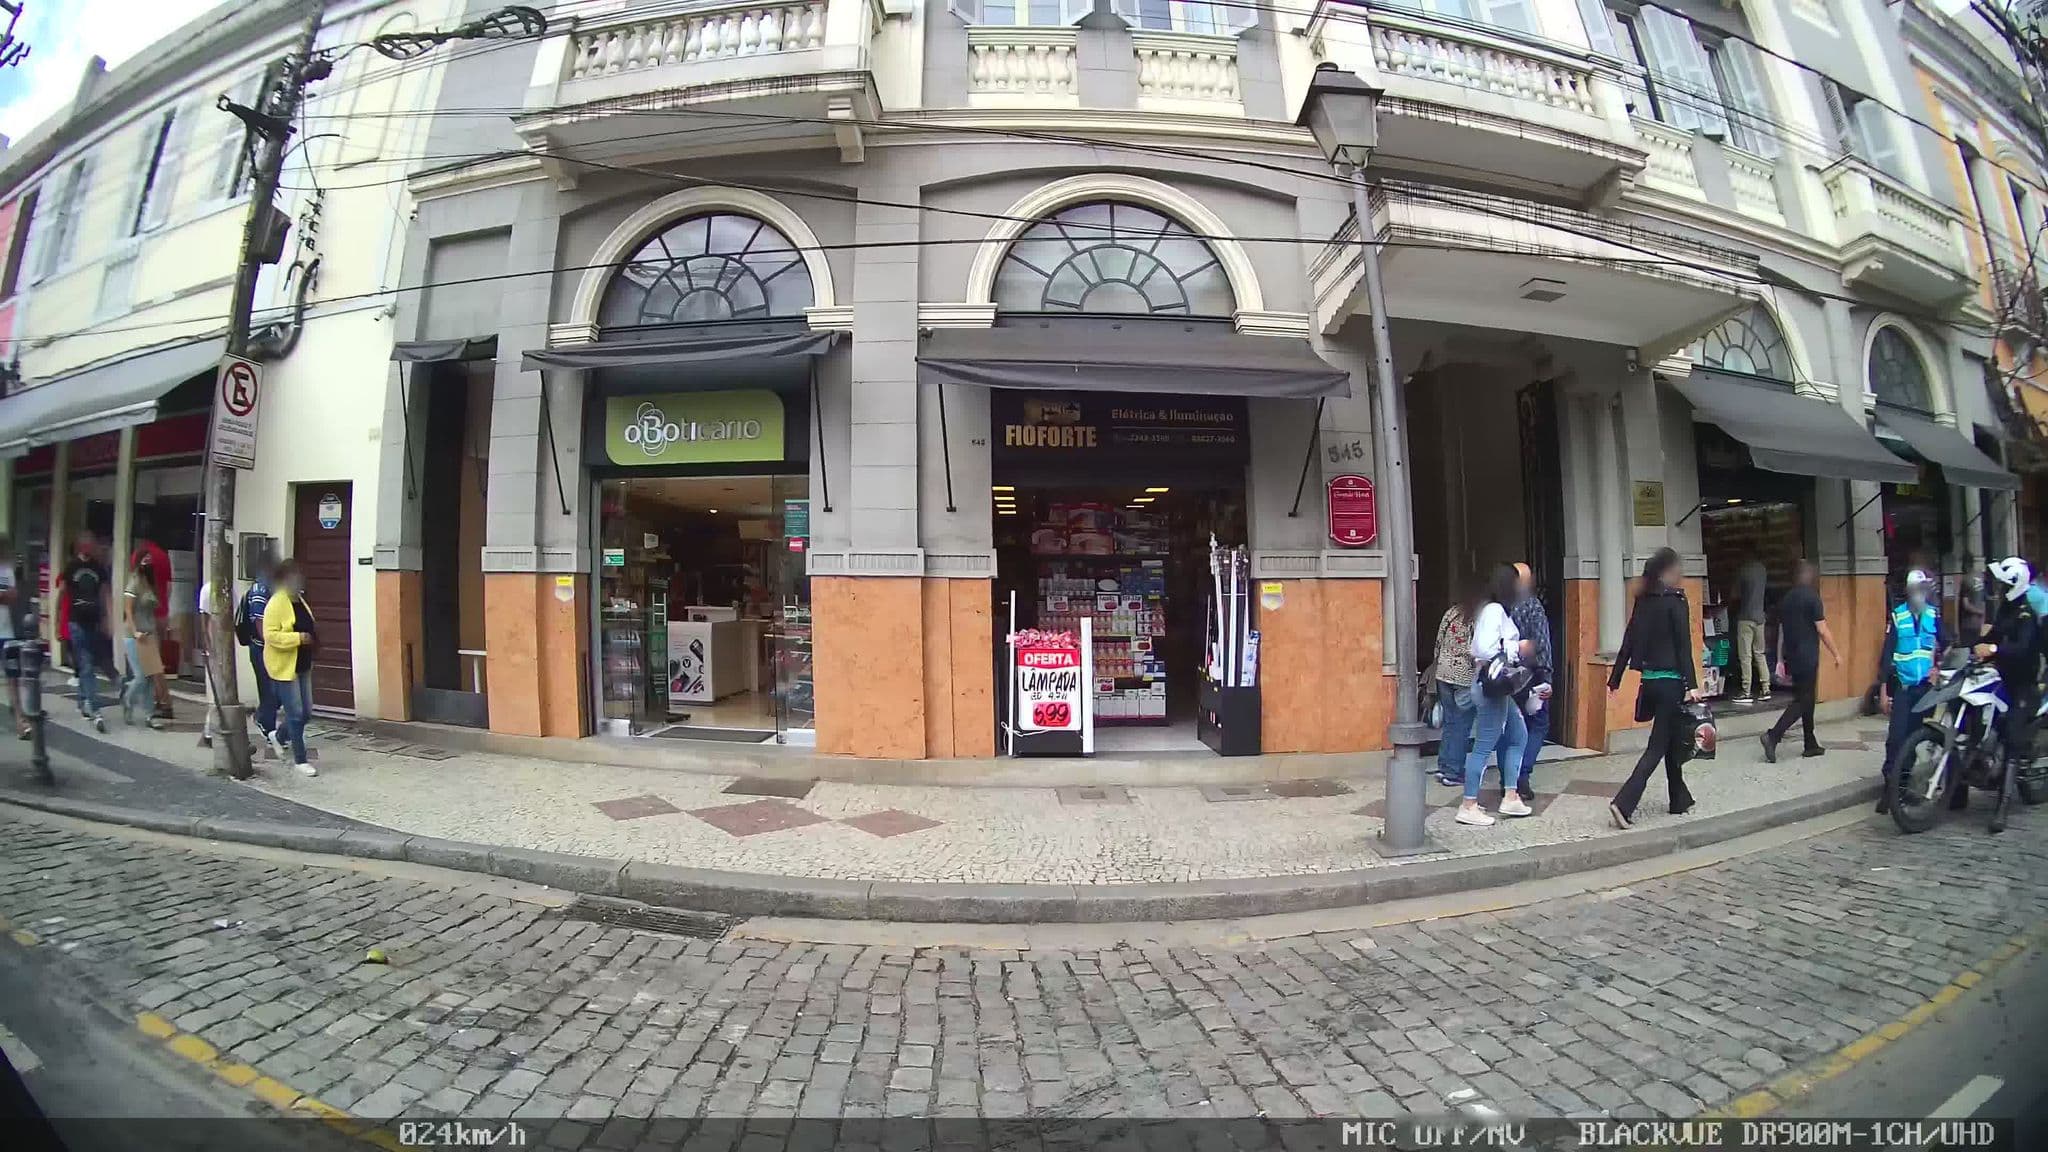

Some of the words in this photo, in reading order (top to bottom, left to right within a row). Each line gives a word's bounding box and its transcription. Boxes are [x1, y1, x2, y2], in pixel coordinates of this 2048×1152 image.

[1005, 425, 1097, 447] FIOFORTE
[1328, 440, 1364, 463] 545
[1024, 653, 1074, 665] OFERTA
[1022, 668, 1077, 692] LÂMPADA
